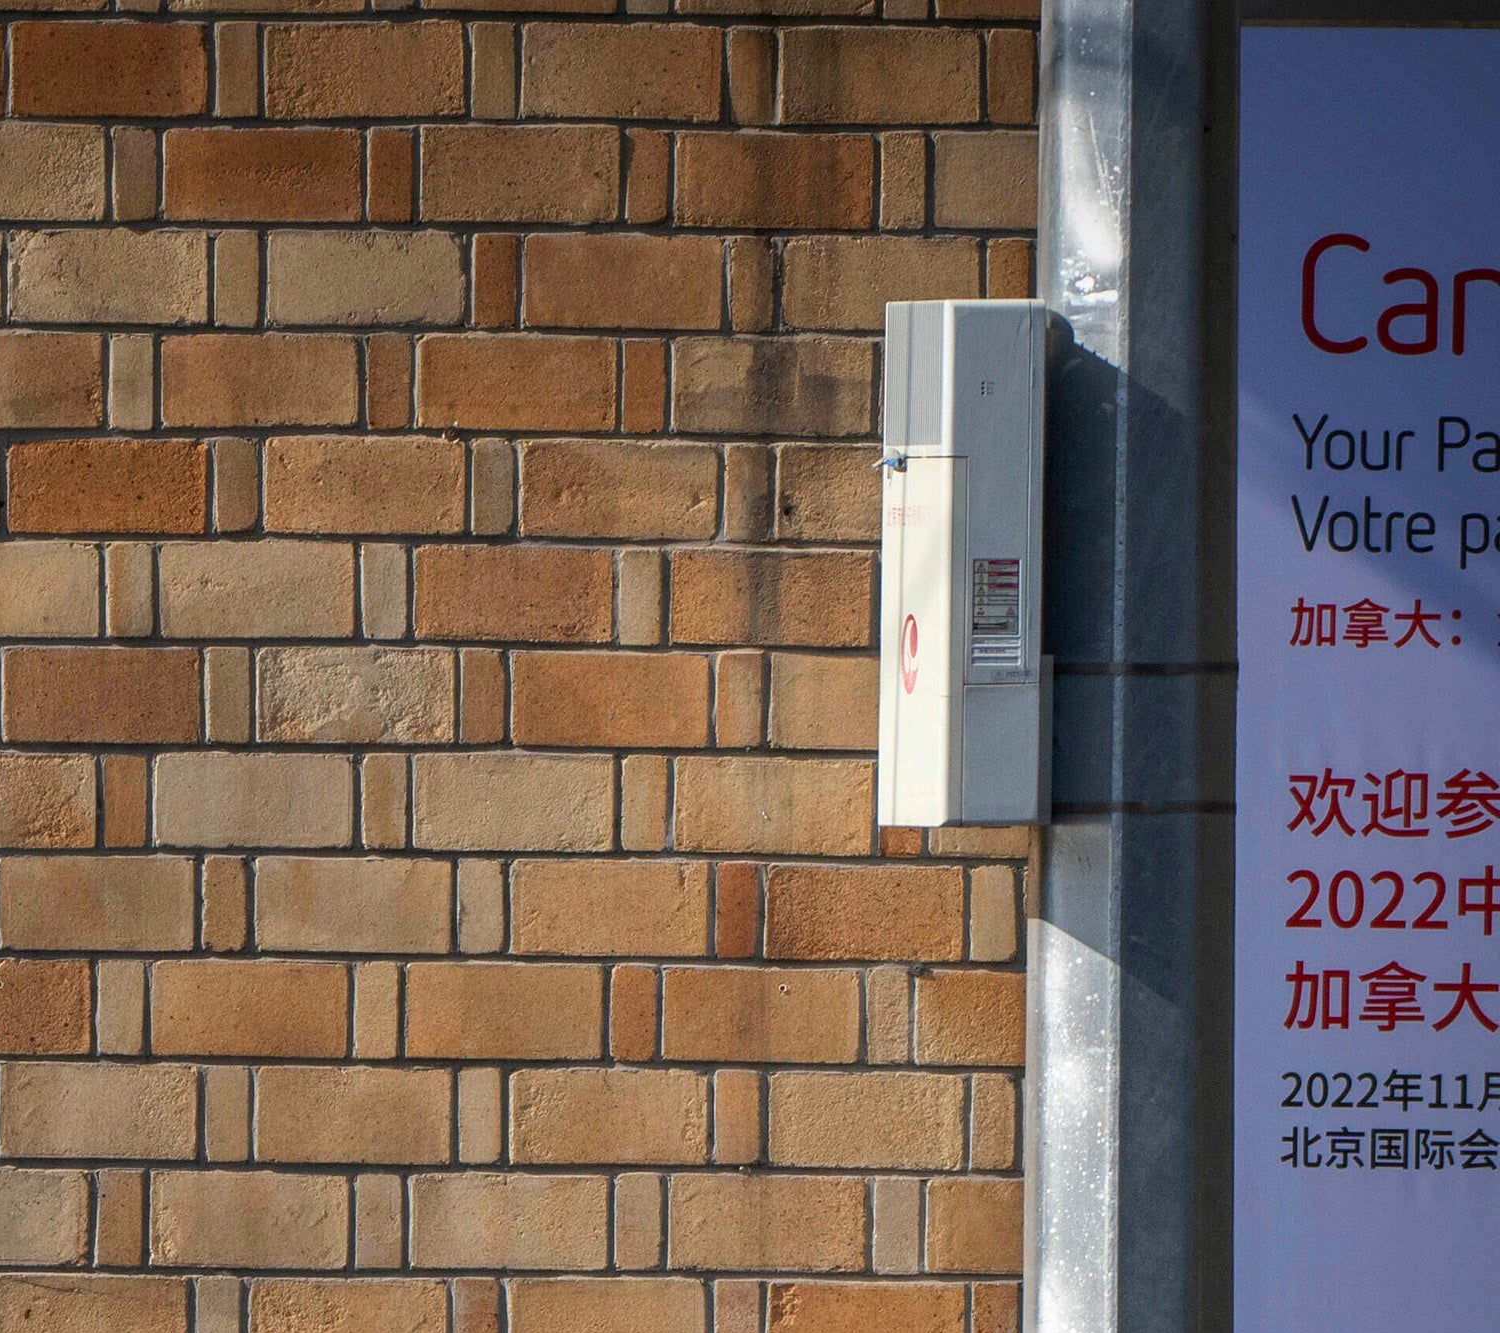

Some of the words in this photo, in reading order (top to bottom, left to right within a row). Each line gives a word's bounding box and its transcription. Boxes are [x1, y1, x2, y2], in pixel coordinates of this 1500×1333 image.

[1292, 413, 1416, 472] Your
[1438, 415, 1500, 474] Pa
[1291, 494, 1436, 555] Votre
[1460, 512, 1500, 571] p
[1290, 597, 1500, 649] 加拿大：
[1287, 767, 1500, 840] 欢迎参
[1283, 960, 1500, 1033] 加拿大
[1280, 1126, 1500, 1171] 北京国际会
